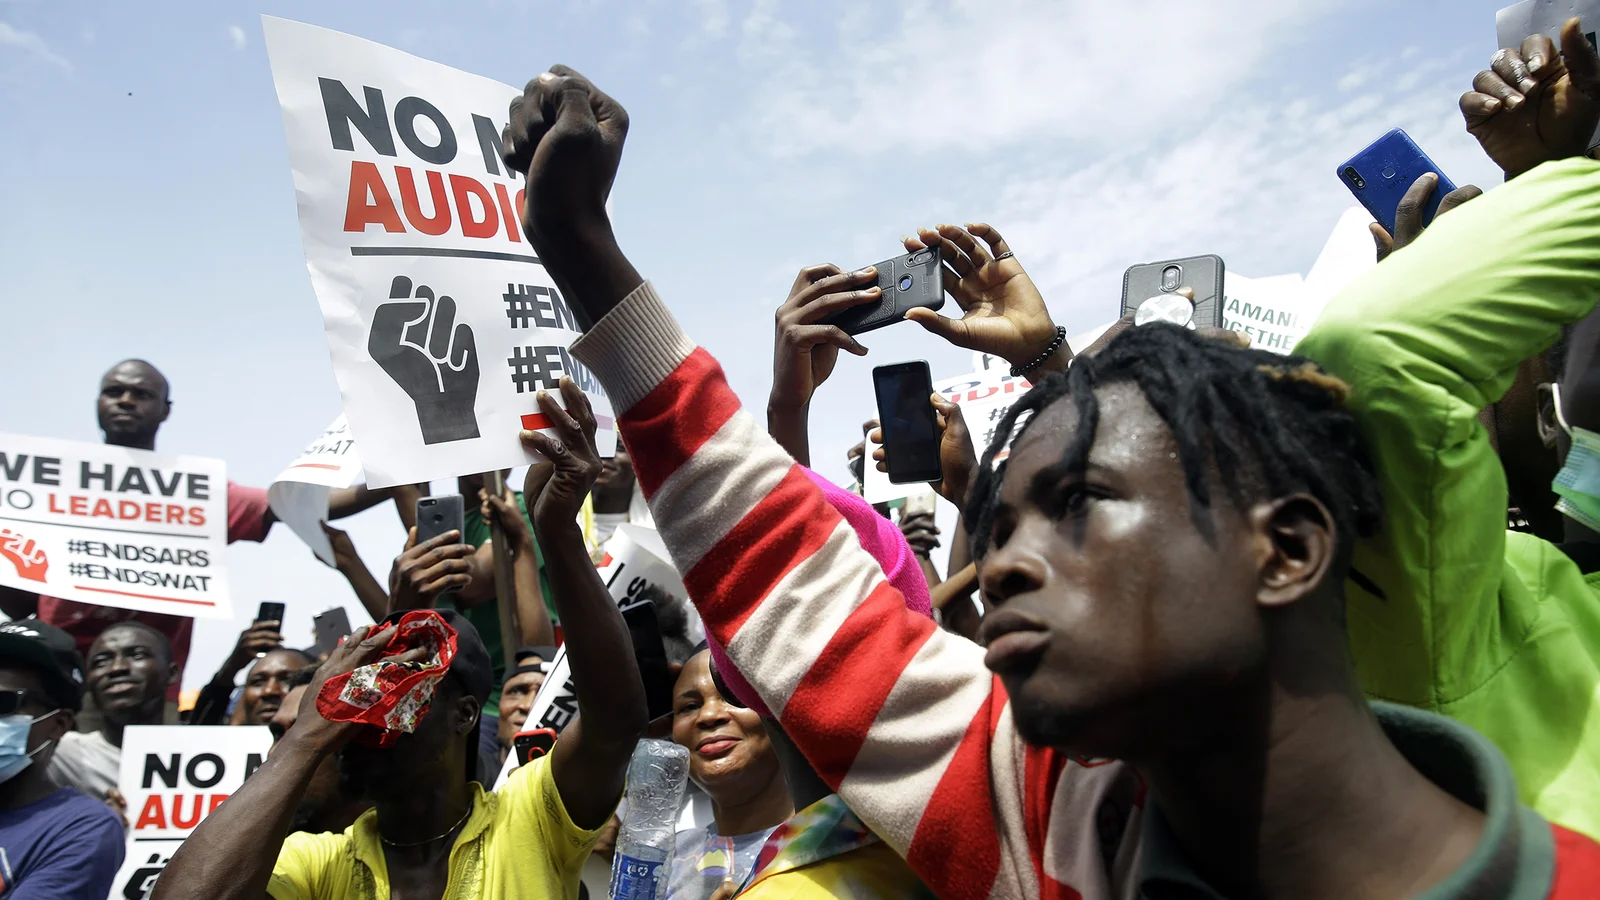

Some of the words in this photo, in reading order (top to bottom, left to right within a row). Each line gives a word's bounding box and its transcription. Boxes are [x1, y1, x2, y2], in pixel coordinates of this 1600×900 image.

[318, 77, 458, 165] NO
[343, 160, 526, 244] AUDI
[80, 461, 209, 500] HAVE
[0, 488, 34, 509] O
[48, 493, 206, 526] LEADERS
[67, 539, 209, 567] #ENDSARS
[68, 562, 211, 592] #ENDSWAT
[142, 753, 225, 788] NO
